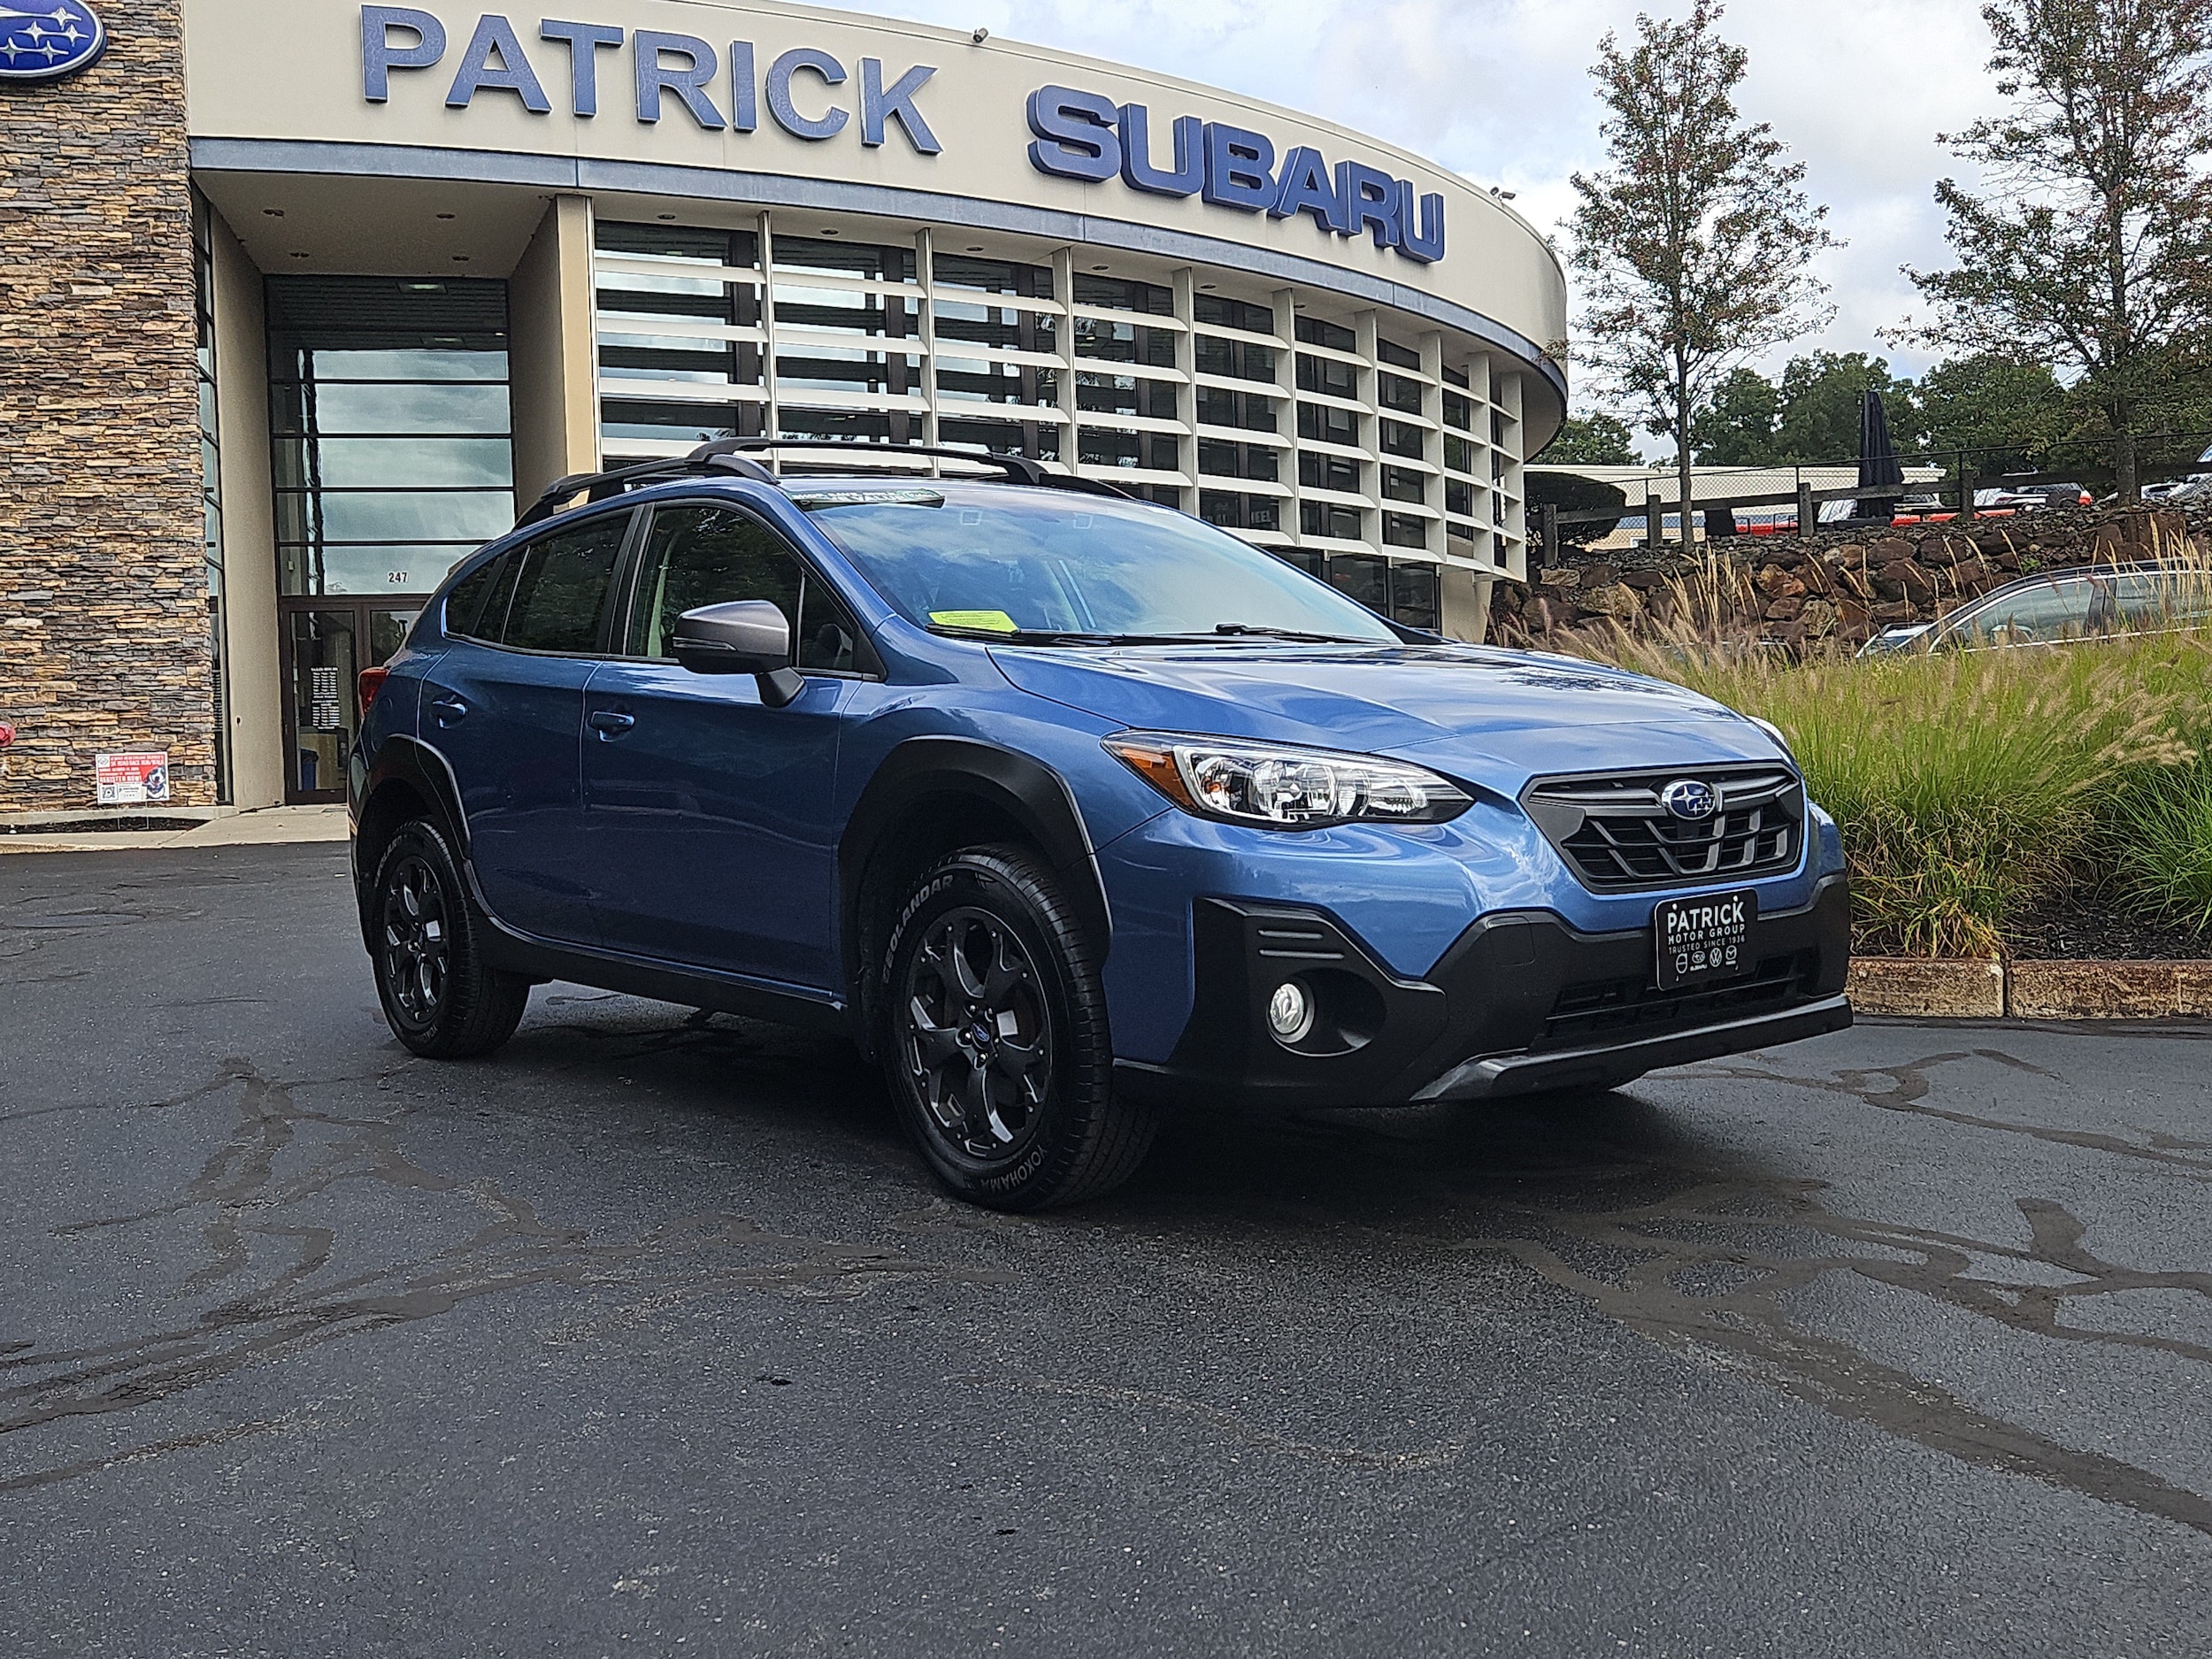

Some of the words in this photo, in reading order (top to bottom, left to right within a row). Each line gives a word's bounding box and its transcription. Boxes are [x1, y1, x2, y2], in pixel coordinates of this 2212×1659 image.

[360, 6, 941, 155] PATRICK
[1026, 85, 1445, 264] SUBARU
[388, 572, 407, 583] 247
[1667, 902, 1745, 933] PATRICK
[1668, 930, 1704, 946] MOTOR
[1709, 923, 1745, 938] GROUP
[1669, 942, 1701, 955] TRUSTED
[1703, 937, 1726, 949] SINCE
